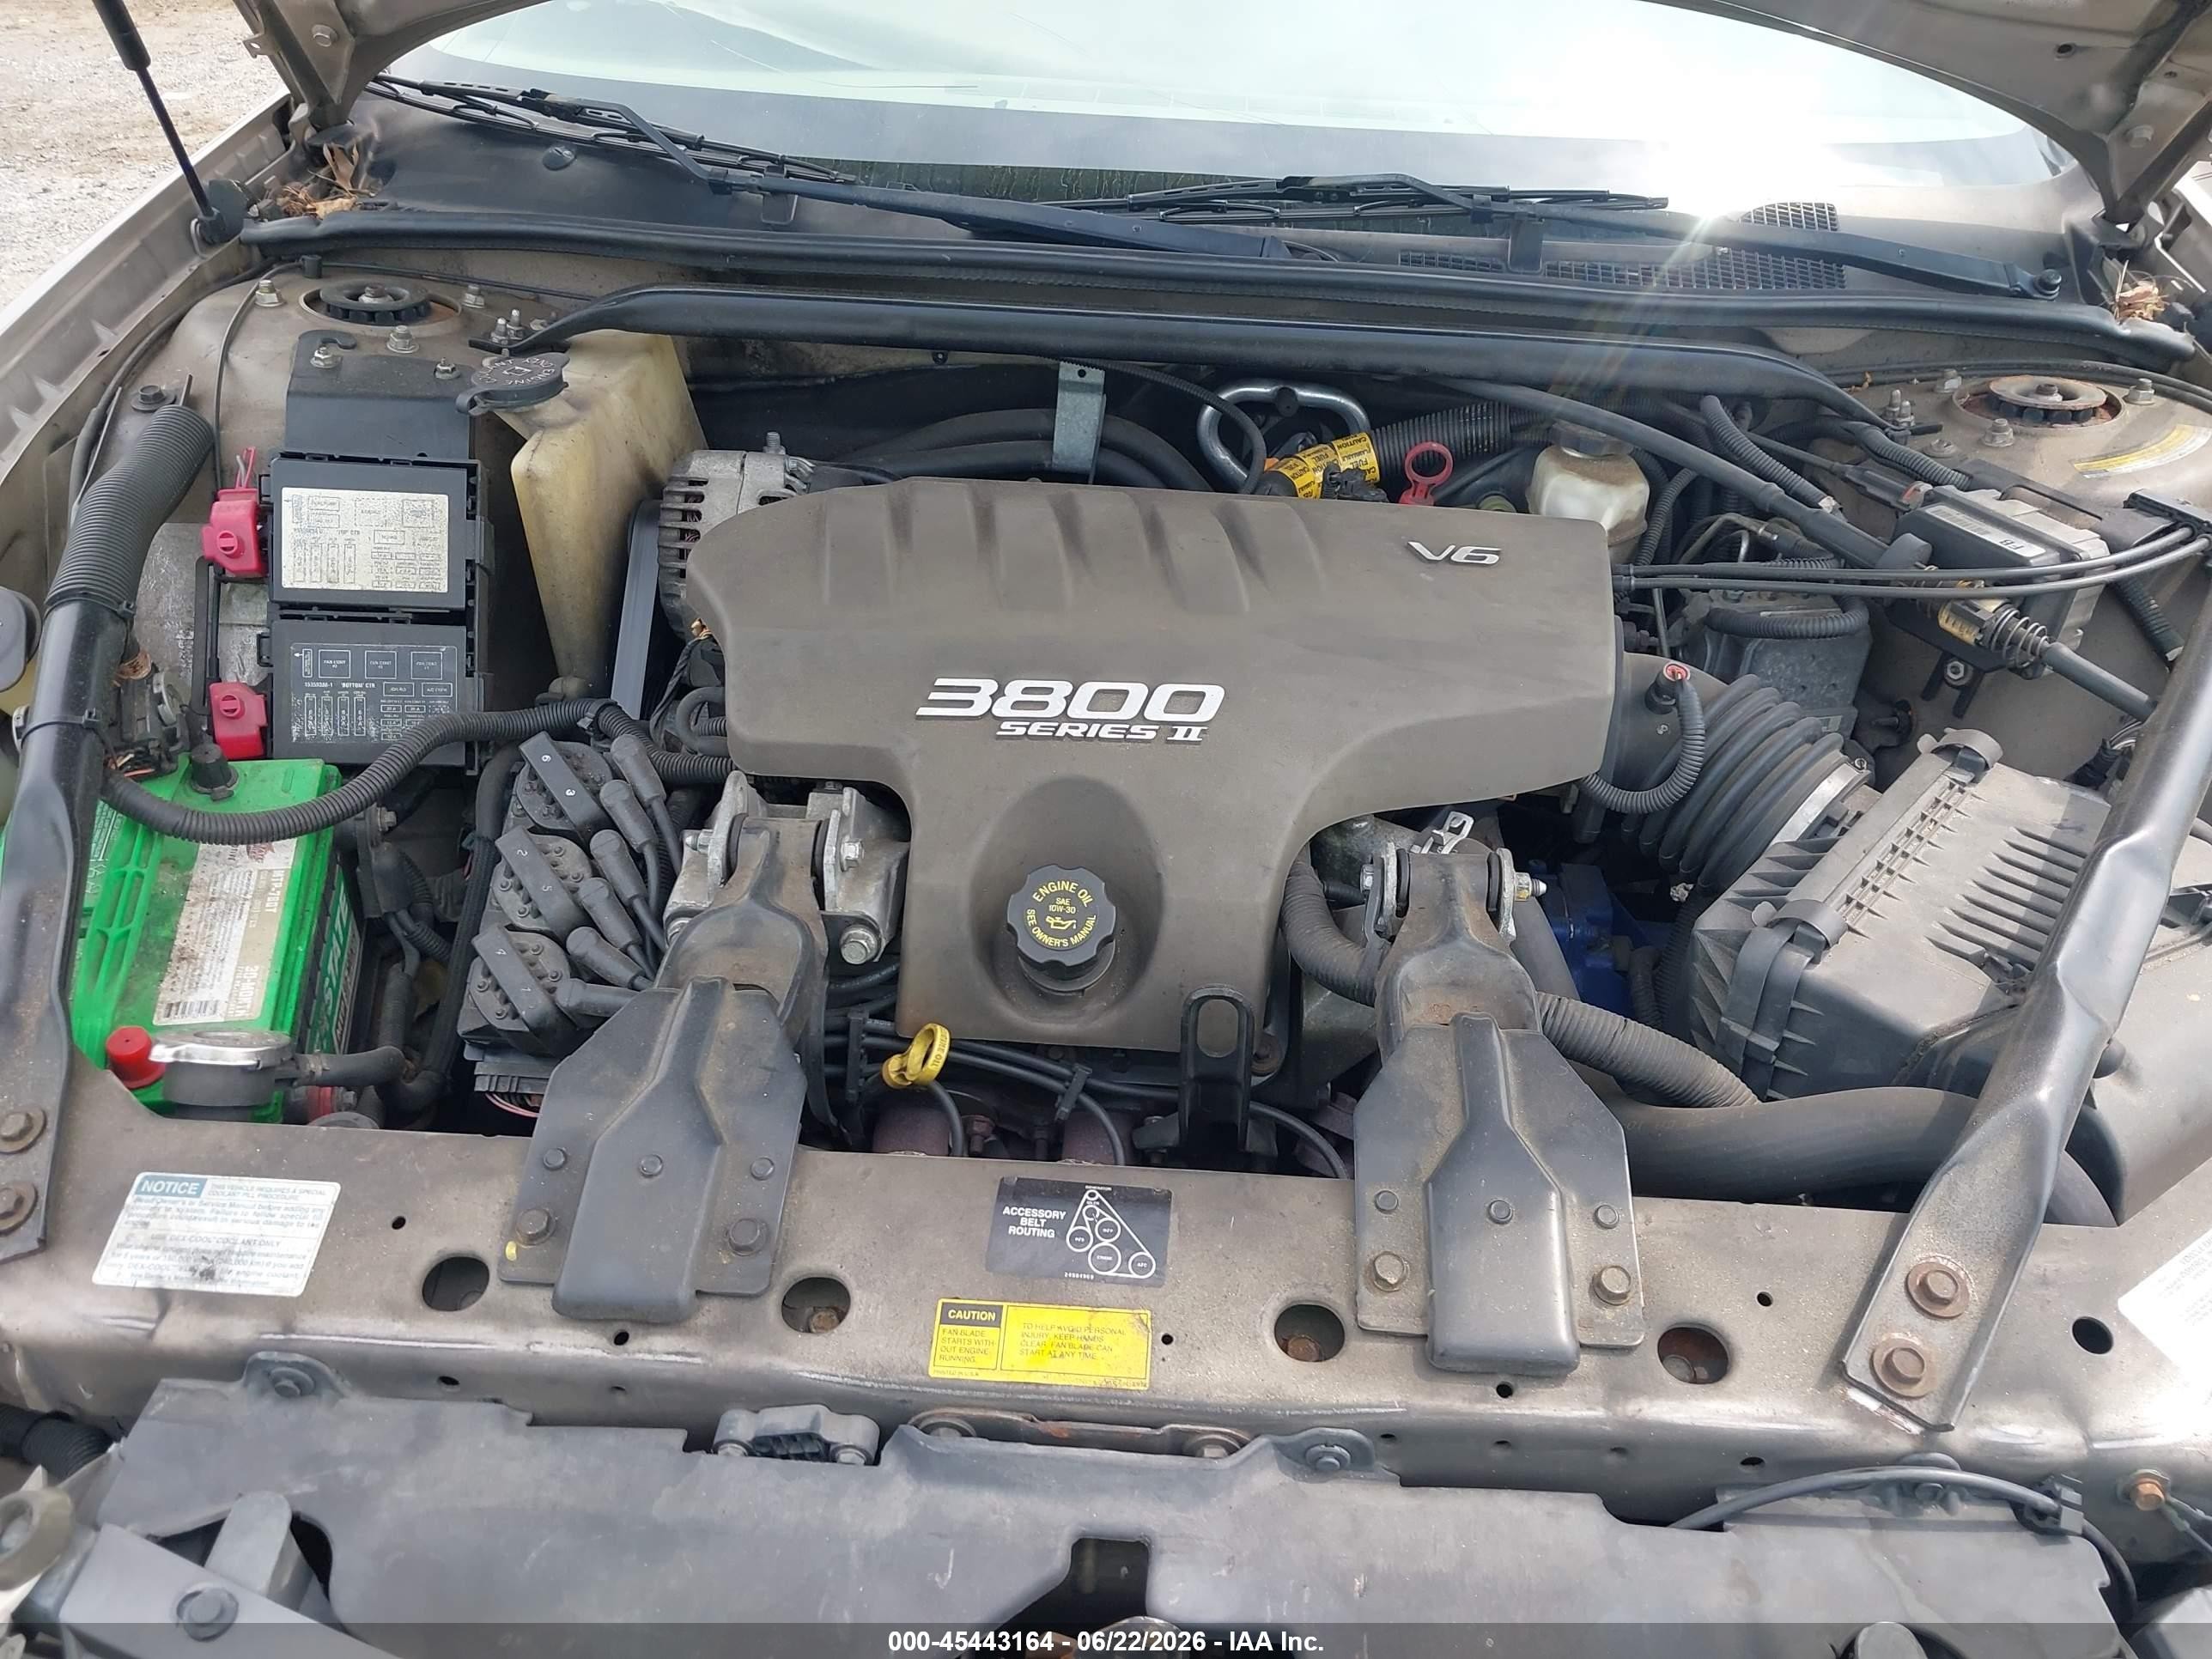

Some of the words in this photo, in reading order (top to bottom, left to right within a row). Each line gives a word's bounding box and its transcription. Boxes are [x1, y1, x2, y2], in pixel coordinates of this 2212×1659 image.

[1337, 436, 1367, 450] CAUTION
[1350, 458, 1369, 469] FUEL
[1999, 539, 2024, 550] FB
[1407, 541, 1502, 564] V6
[915, 678, 1225, 722] 3800
[995, 721, 1159, 740] SERIES
[1165, 726, 1208, 741] II
[1032, 880, 1079, 902] ENGINE
[1077, 889, 1093, 907] OIL
[1055, 897, 1071, 906] SAE
[1048, 905, 1076, 914] 10W-30
[1026, 908, 1037, 927] SEE
[1032, 927, 1068, 947] OWNER'S
[1069, 915, 1097, 945] MANUAL
[930, 1054, 942, 1067] OIL
[141, 1180, 200, 1194] NOTICE
[1002, 1206, 1066, 1220] ACCESSORY
[1019, 1217, 1047, 1227] BELT
[1008, 1225, 1055, 1238] ROUTING
[948, 1309, 996, 1321] CAUTION
[1084, 1326, 1127, 1335] PERSONAL
[940, 1337, 972, 1346] STARTS
